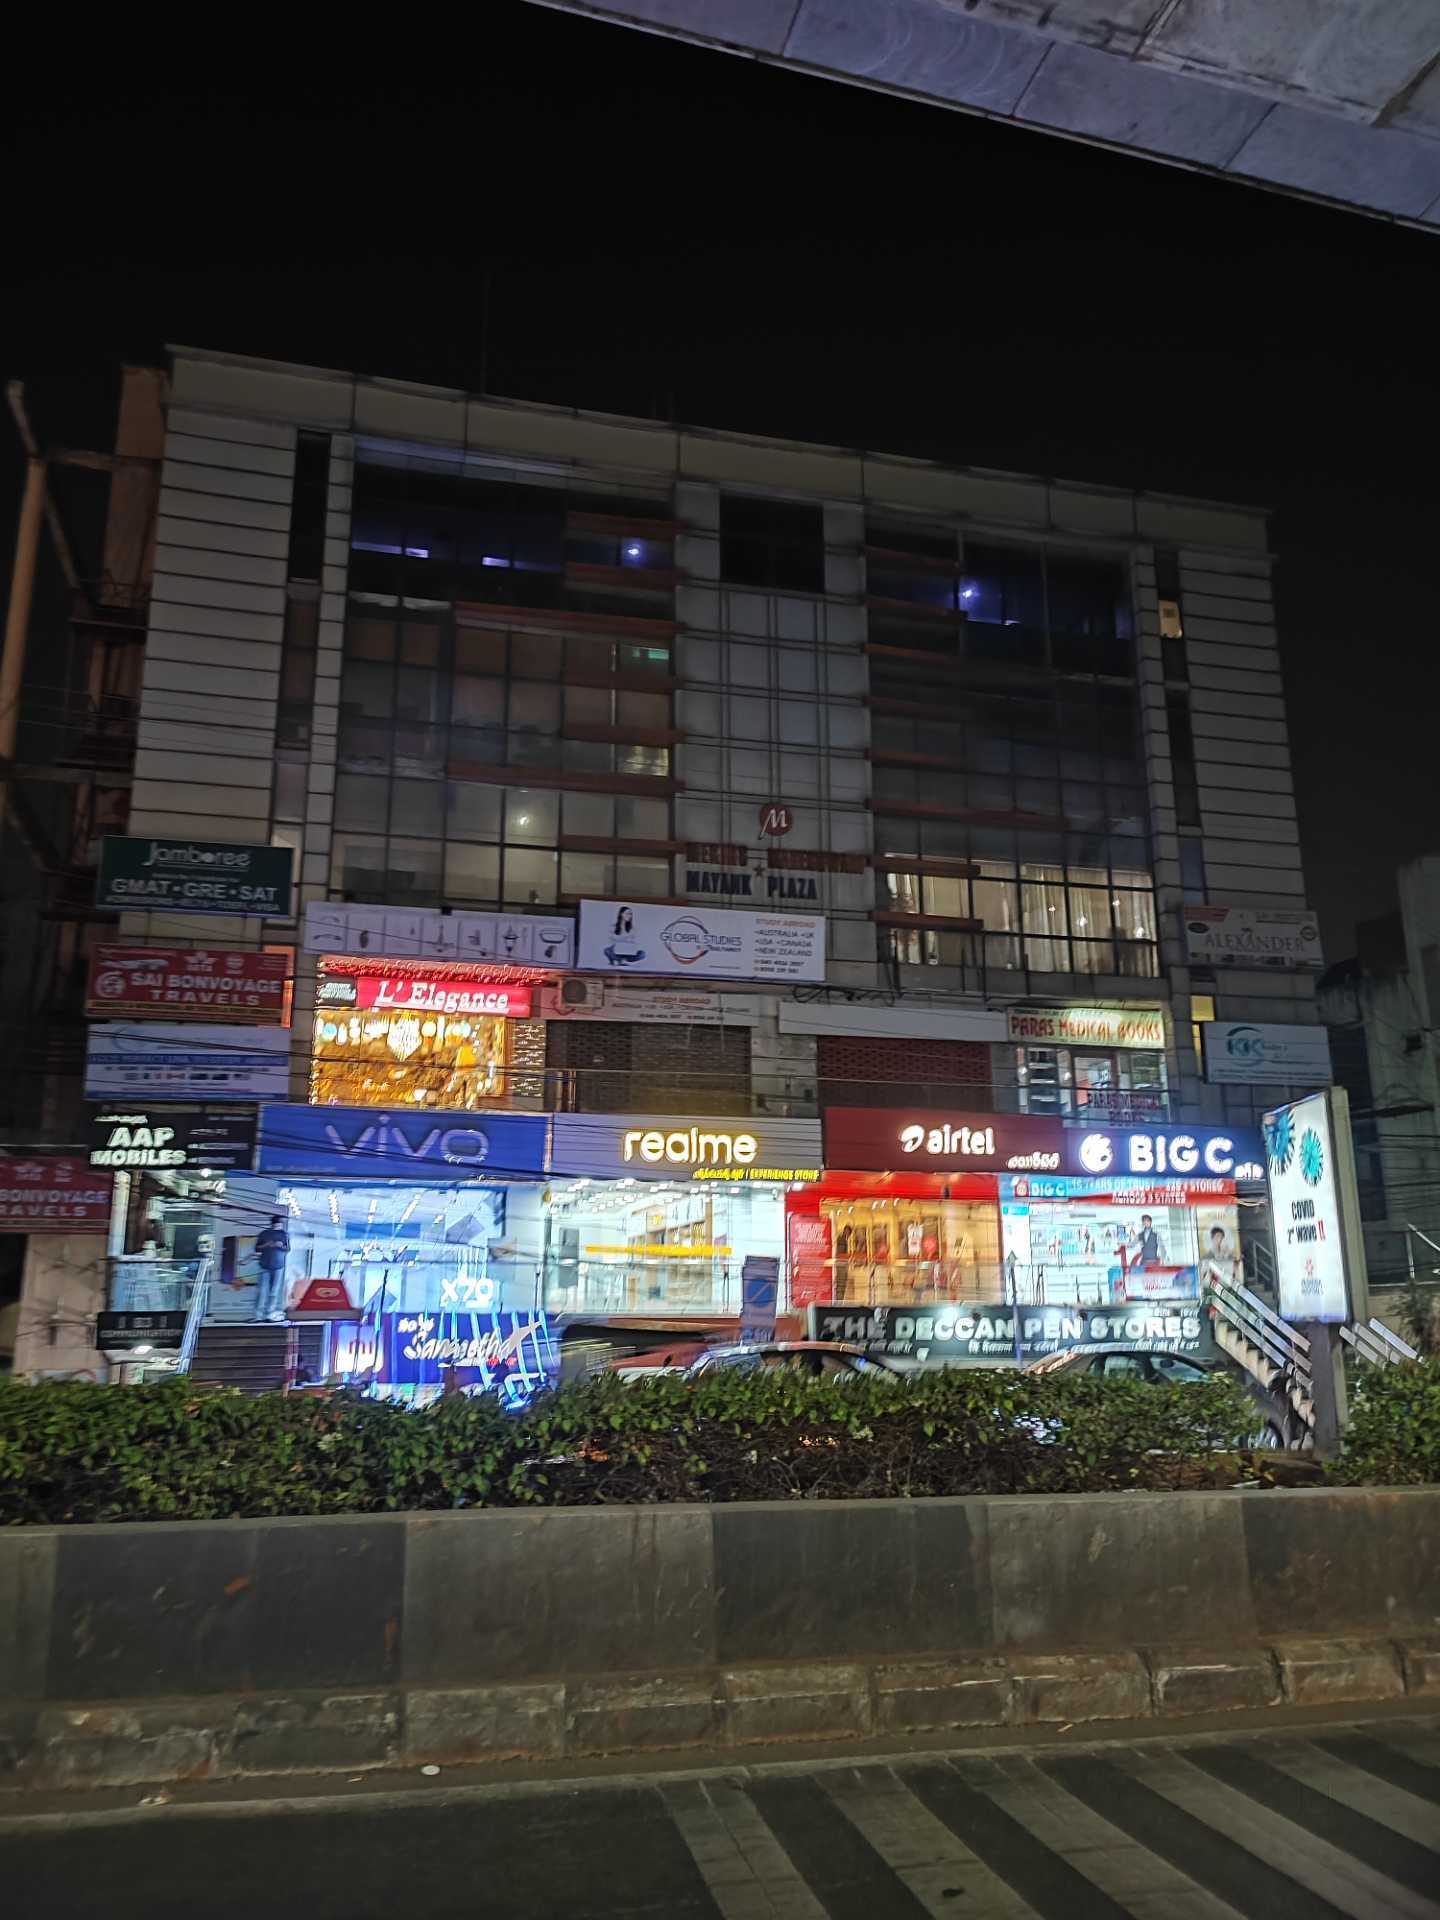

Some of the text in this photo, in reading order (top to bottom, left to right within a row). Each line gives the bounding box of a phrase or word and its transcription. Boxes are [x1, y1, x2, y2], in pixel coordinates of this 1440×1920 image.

[141, 841, 251, 867] Jamboree
[111, 878, 172, 895] GMAT
[183, 882, 228, 899] GRE
[239, 885, 279, 901] SAT
[767, 875, 818, 900] PLAZA
[659, 931, 743, 947] GLOBAL STUDIES
[1205, 933, 1306, 952] ALEXANDER
[130, 972, 281, 994] SAI BONVOYAGE
[149, 989, 260, 1006] TRAVELS
[410, 982, 509, 1012] Elegance
[1010, 1016, 1161, 1041] PARAS MEDICAL BOOKS
[106, 1126, 175, 1148] AAP
[325, 1113, 490, 1163] vivo
[623, 1127, 758, 1165] realme
[926, 1123, 996, 1155] airtel
[1111, 1191, 1146, 1204] ACROSS
[1155, 1192, 1187, 1204] STATES
[1190, 1180, 1225, 1193] STORES
[1291, 1199, 1315, 1222] COVID
[1296, 1224, 1318, 1243] wave
[820, 1315, 1201, 1341] THE DECCAN PEN STORES
